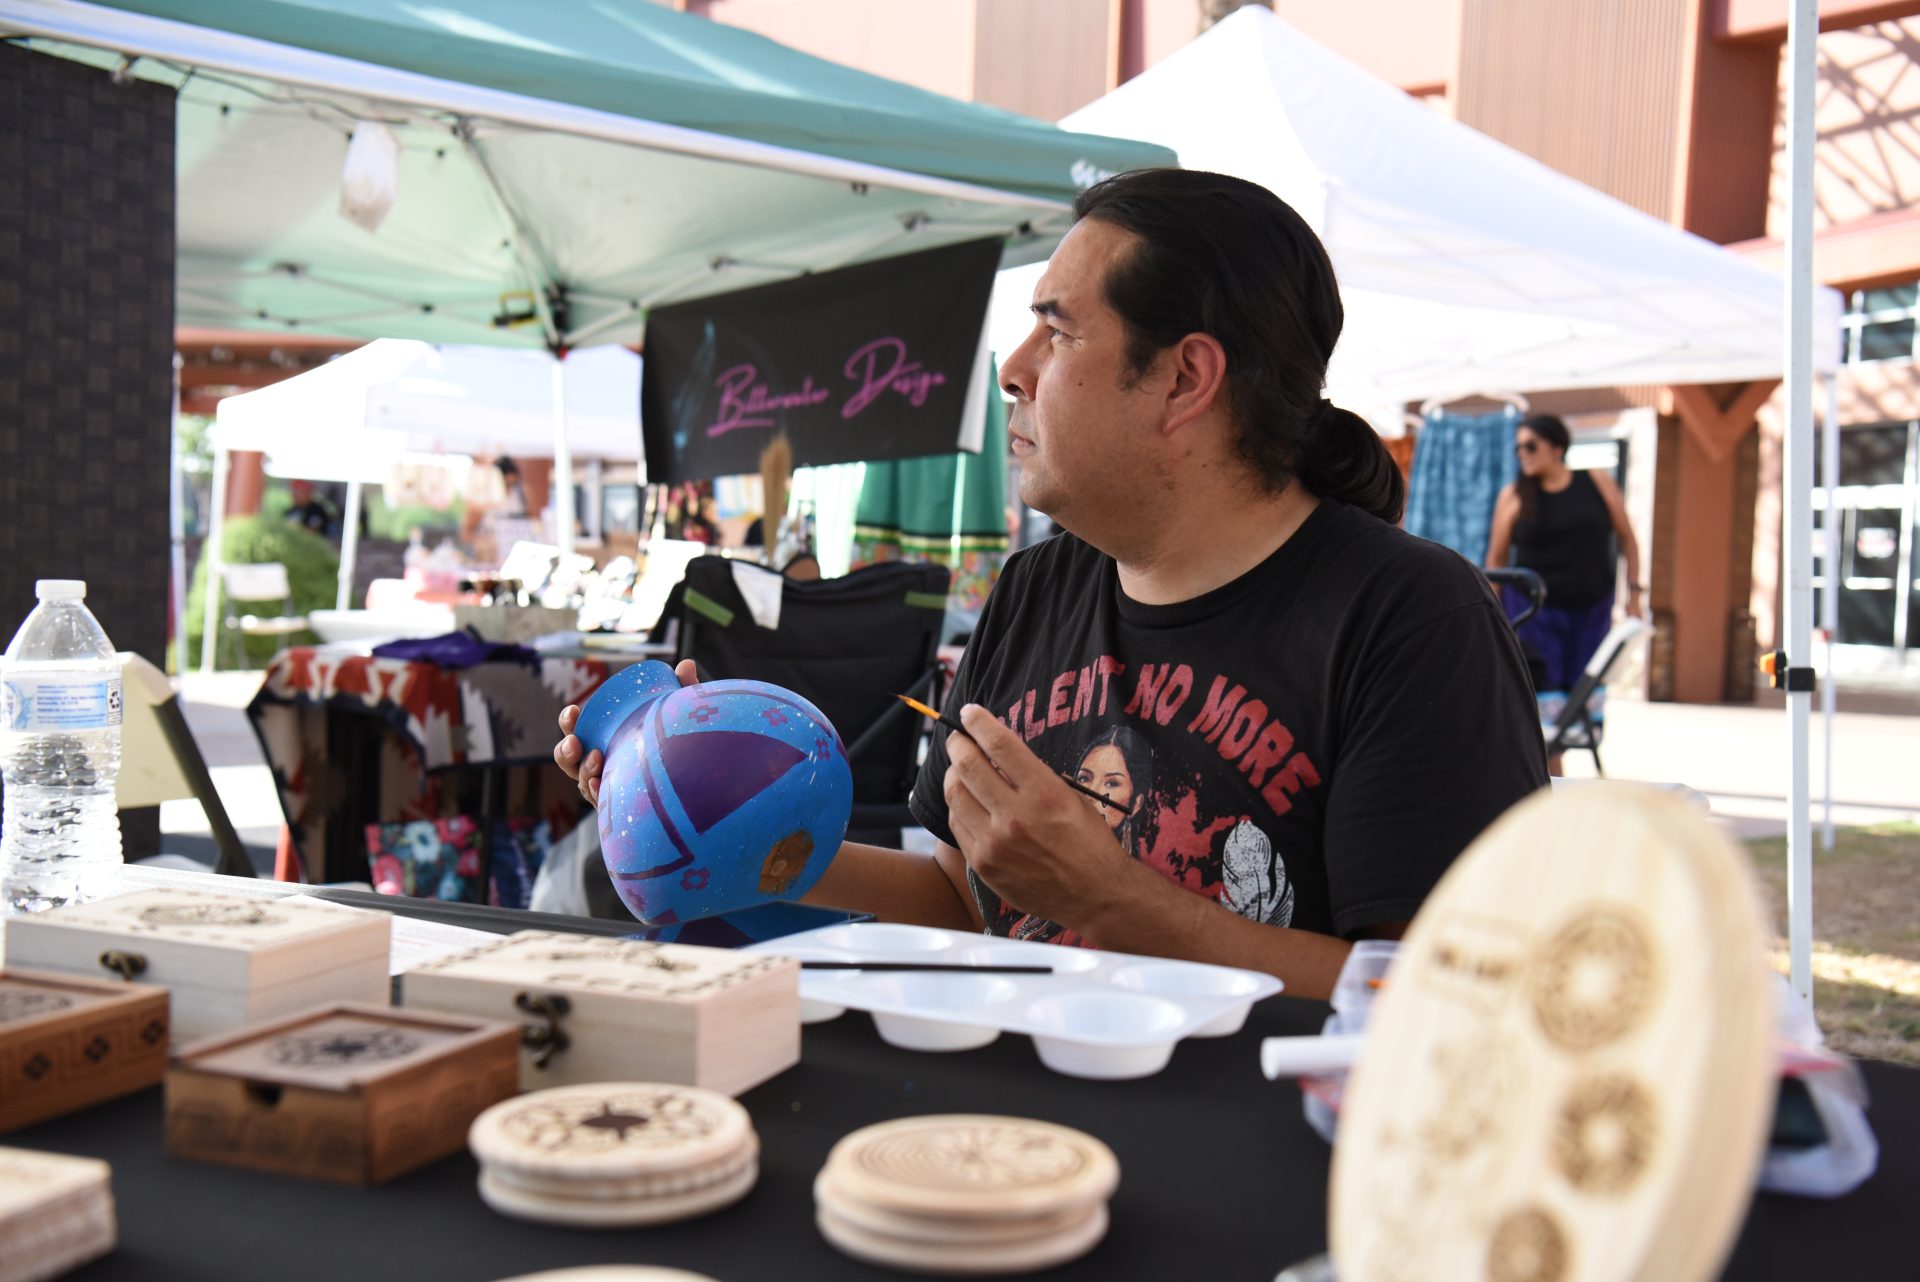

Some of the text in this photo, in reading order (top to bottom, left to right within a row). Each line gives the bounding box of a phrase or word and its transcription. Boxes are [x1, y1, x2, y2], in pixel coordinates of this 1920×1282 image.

[840, 336, 947, 419] Design
[998, 655, 1322, 816] ILENT NO MORE
